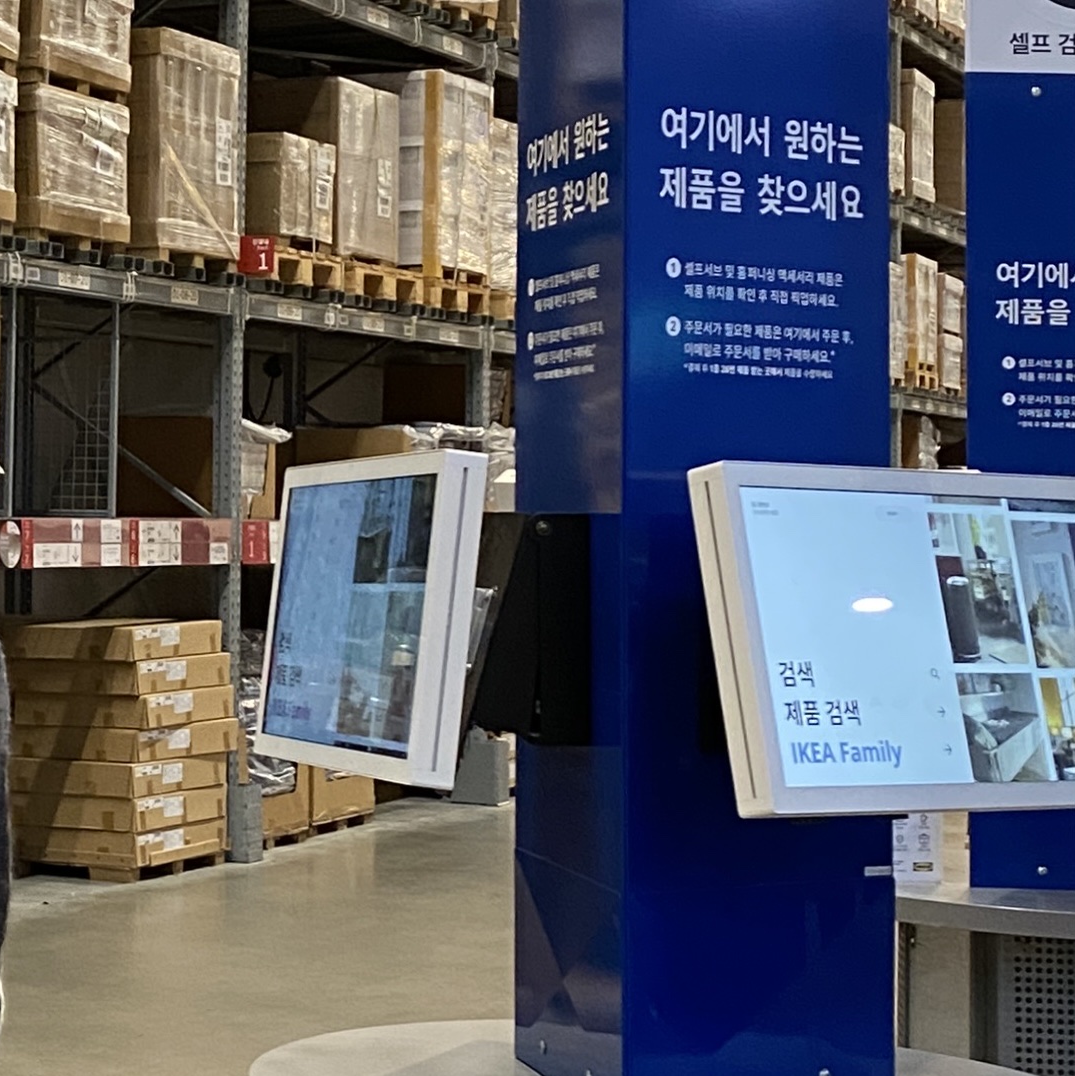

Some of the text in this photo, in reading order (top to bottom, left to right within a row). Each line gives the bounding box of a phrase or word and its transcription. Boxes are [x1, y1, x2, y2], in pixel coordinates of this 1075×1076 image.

[1009, 32, 1075, 56] 셀프 검
[526, 112, 610, 178] 여기에서 원하는
[660, 106, 864, 165] 여기에서 원하는
[525, 171, 610, 232] 제품을 찾으세요
[659, 166, 865, 222] 제품을 찾으세요
[257, 252, 269, 270] 1
[684, 261, 724, 277] 셀프서브
[725, 264, 735, 279] 및
[816, 271, 845, 288] 제품은
[996, 260, 1075, 290] 여기에
[684, 283, 704, 300] 제품
[706, 284, 735, 302] 위치를
[737, 286, 756, 303] 확인
[758, 288, 768, 304] 후
[770, 289, 789, 305] 직접
[995, 297, 1072, 327] 제품을
[684, 320, 723, 336] 주문서가
[724, 322, 753, 339] 필요한
[754, 324, 782, 340] 제품은
[784, 326, 821, 342] 여기에서
[822, 328, 840, 344] 주문
[684, 341, 722, 358] 이메일로
[723, 344, 762, 361] 주문서를
[762, 345, 783, 361] 받아
[1053, 408, 1075, 420] 주문
[778, 660, 816, 688] 검색
[784, 700, 862, 727] 제품 검색
[790, 739, 903, 769] IKEA Family
